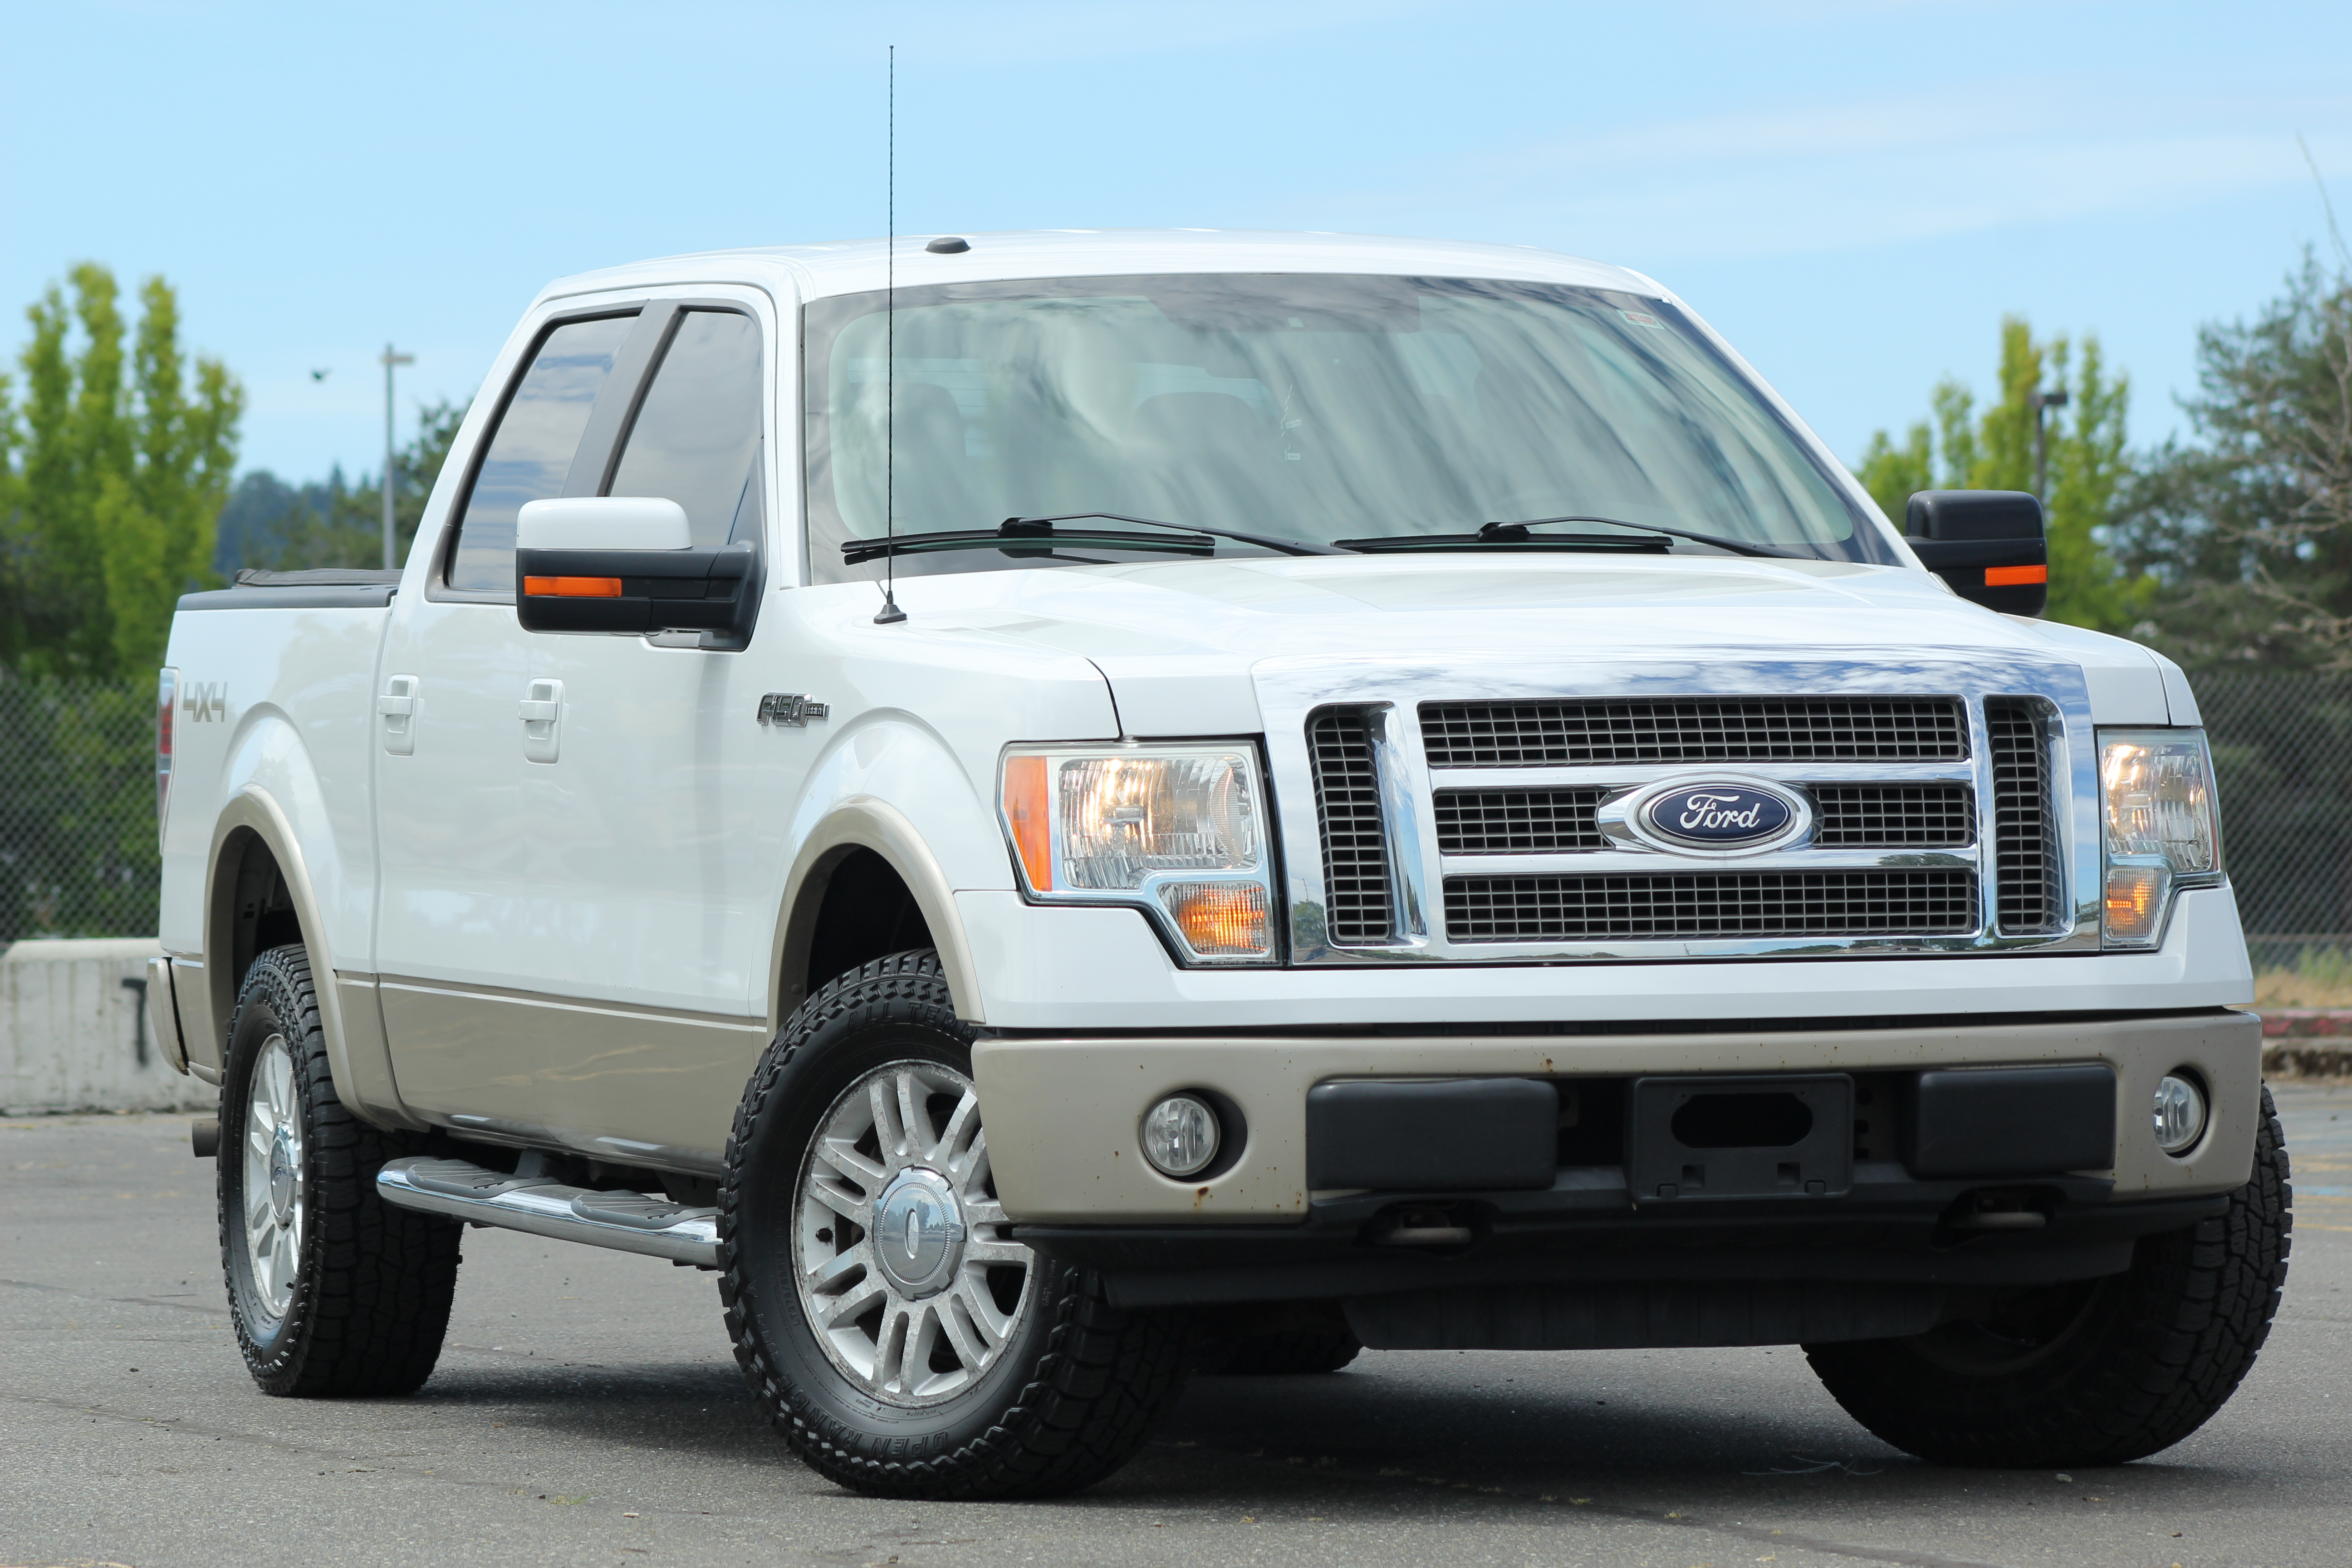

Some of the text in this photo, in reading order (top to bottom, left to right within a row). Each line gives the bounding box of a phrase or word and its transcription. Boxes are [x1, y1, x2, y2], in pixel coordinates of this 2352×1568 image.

[1680, 794, 1761, 829] Ford
[847, 1000, 977, 1043] ALL TERR
[775, 1371, 862, 1449] RANGE
[868, 1429, 948, 1459] OPEN
